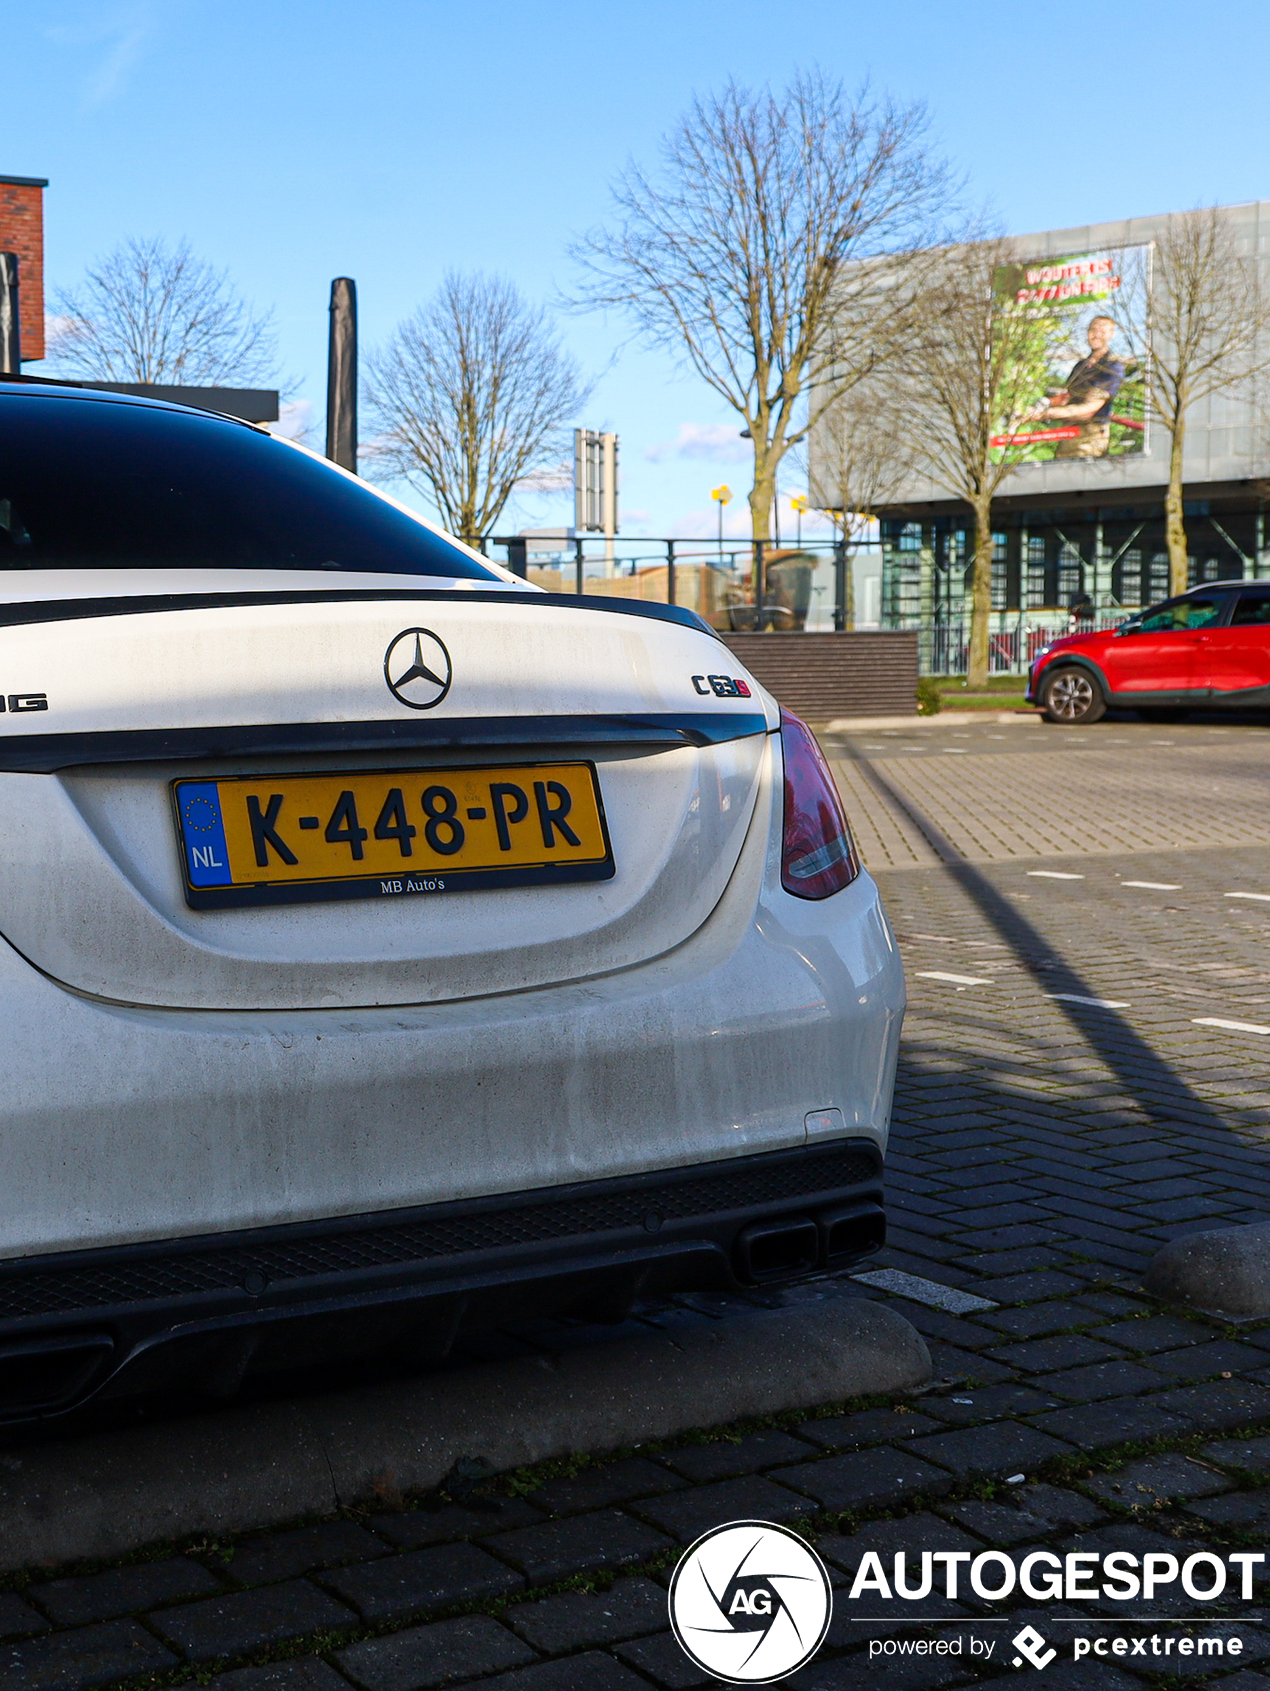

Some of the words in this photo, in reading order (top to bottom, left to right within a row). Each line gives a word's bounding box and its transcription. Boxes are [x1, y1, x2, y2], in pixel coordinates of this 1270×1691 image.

[246, 780, 582, 867] K-448-PR
[192, 846, 223, 868] NL
[380, 880, 403, 894] MB
[406, 877, 446, 892] Auto's
